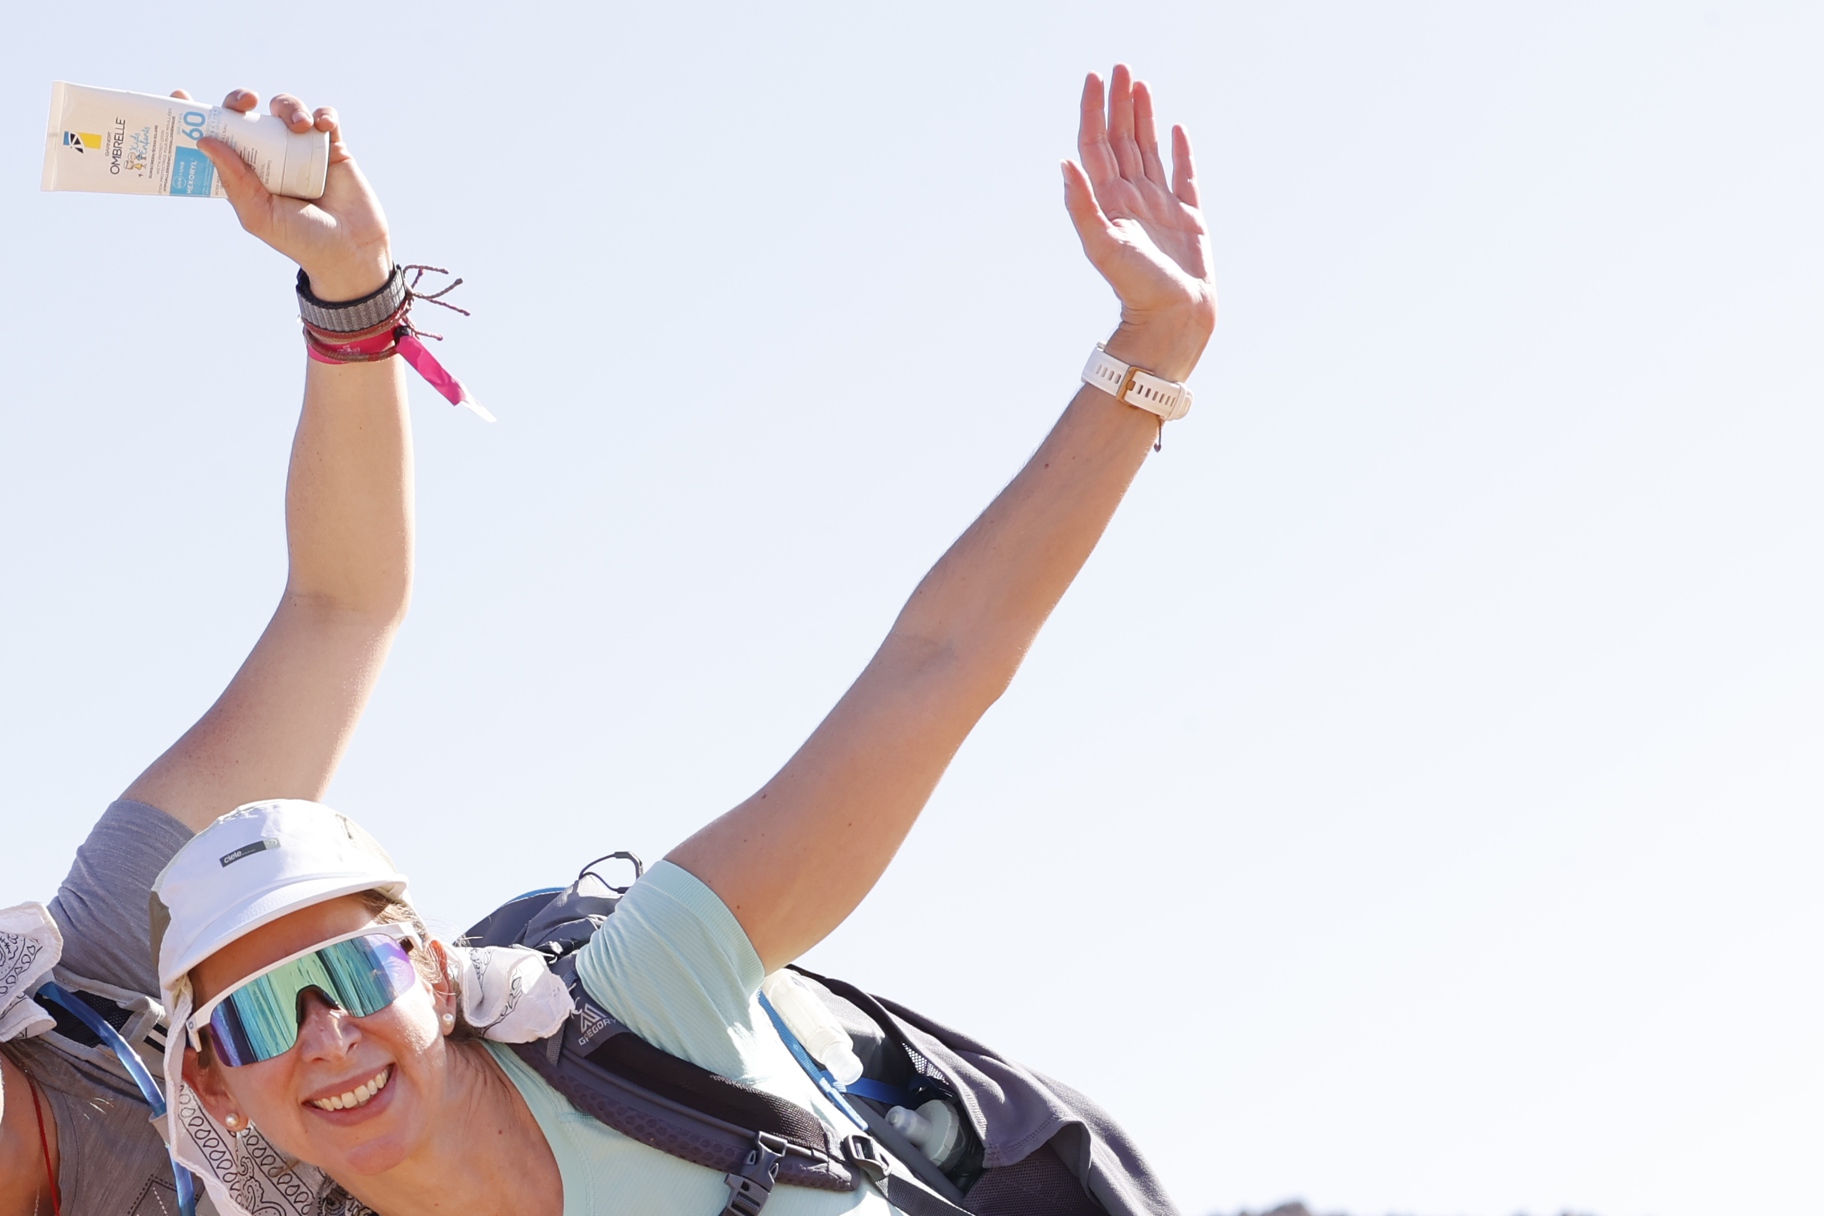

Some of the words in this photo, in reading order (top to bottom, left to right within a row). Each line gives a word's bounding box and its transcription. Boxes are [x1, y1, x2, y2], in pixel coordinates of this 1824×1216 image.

[181, 111, 206, 141] 60
[109, 117, 125, 175] OMBRELLE
[186, 160, 197, 194] MEXORYL
[578, 1018, 616, 1046] GREGORY
